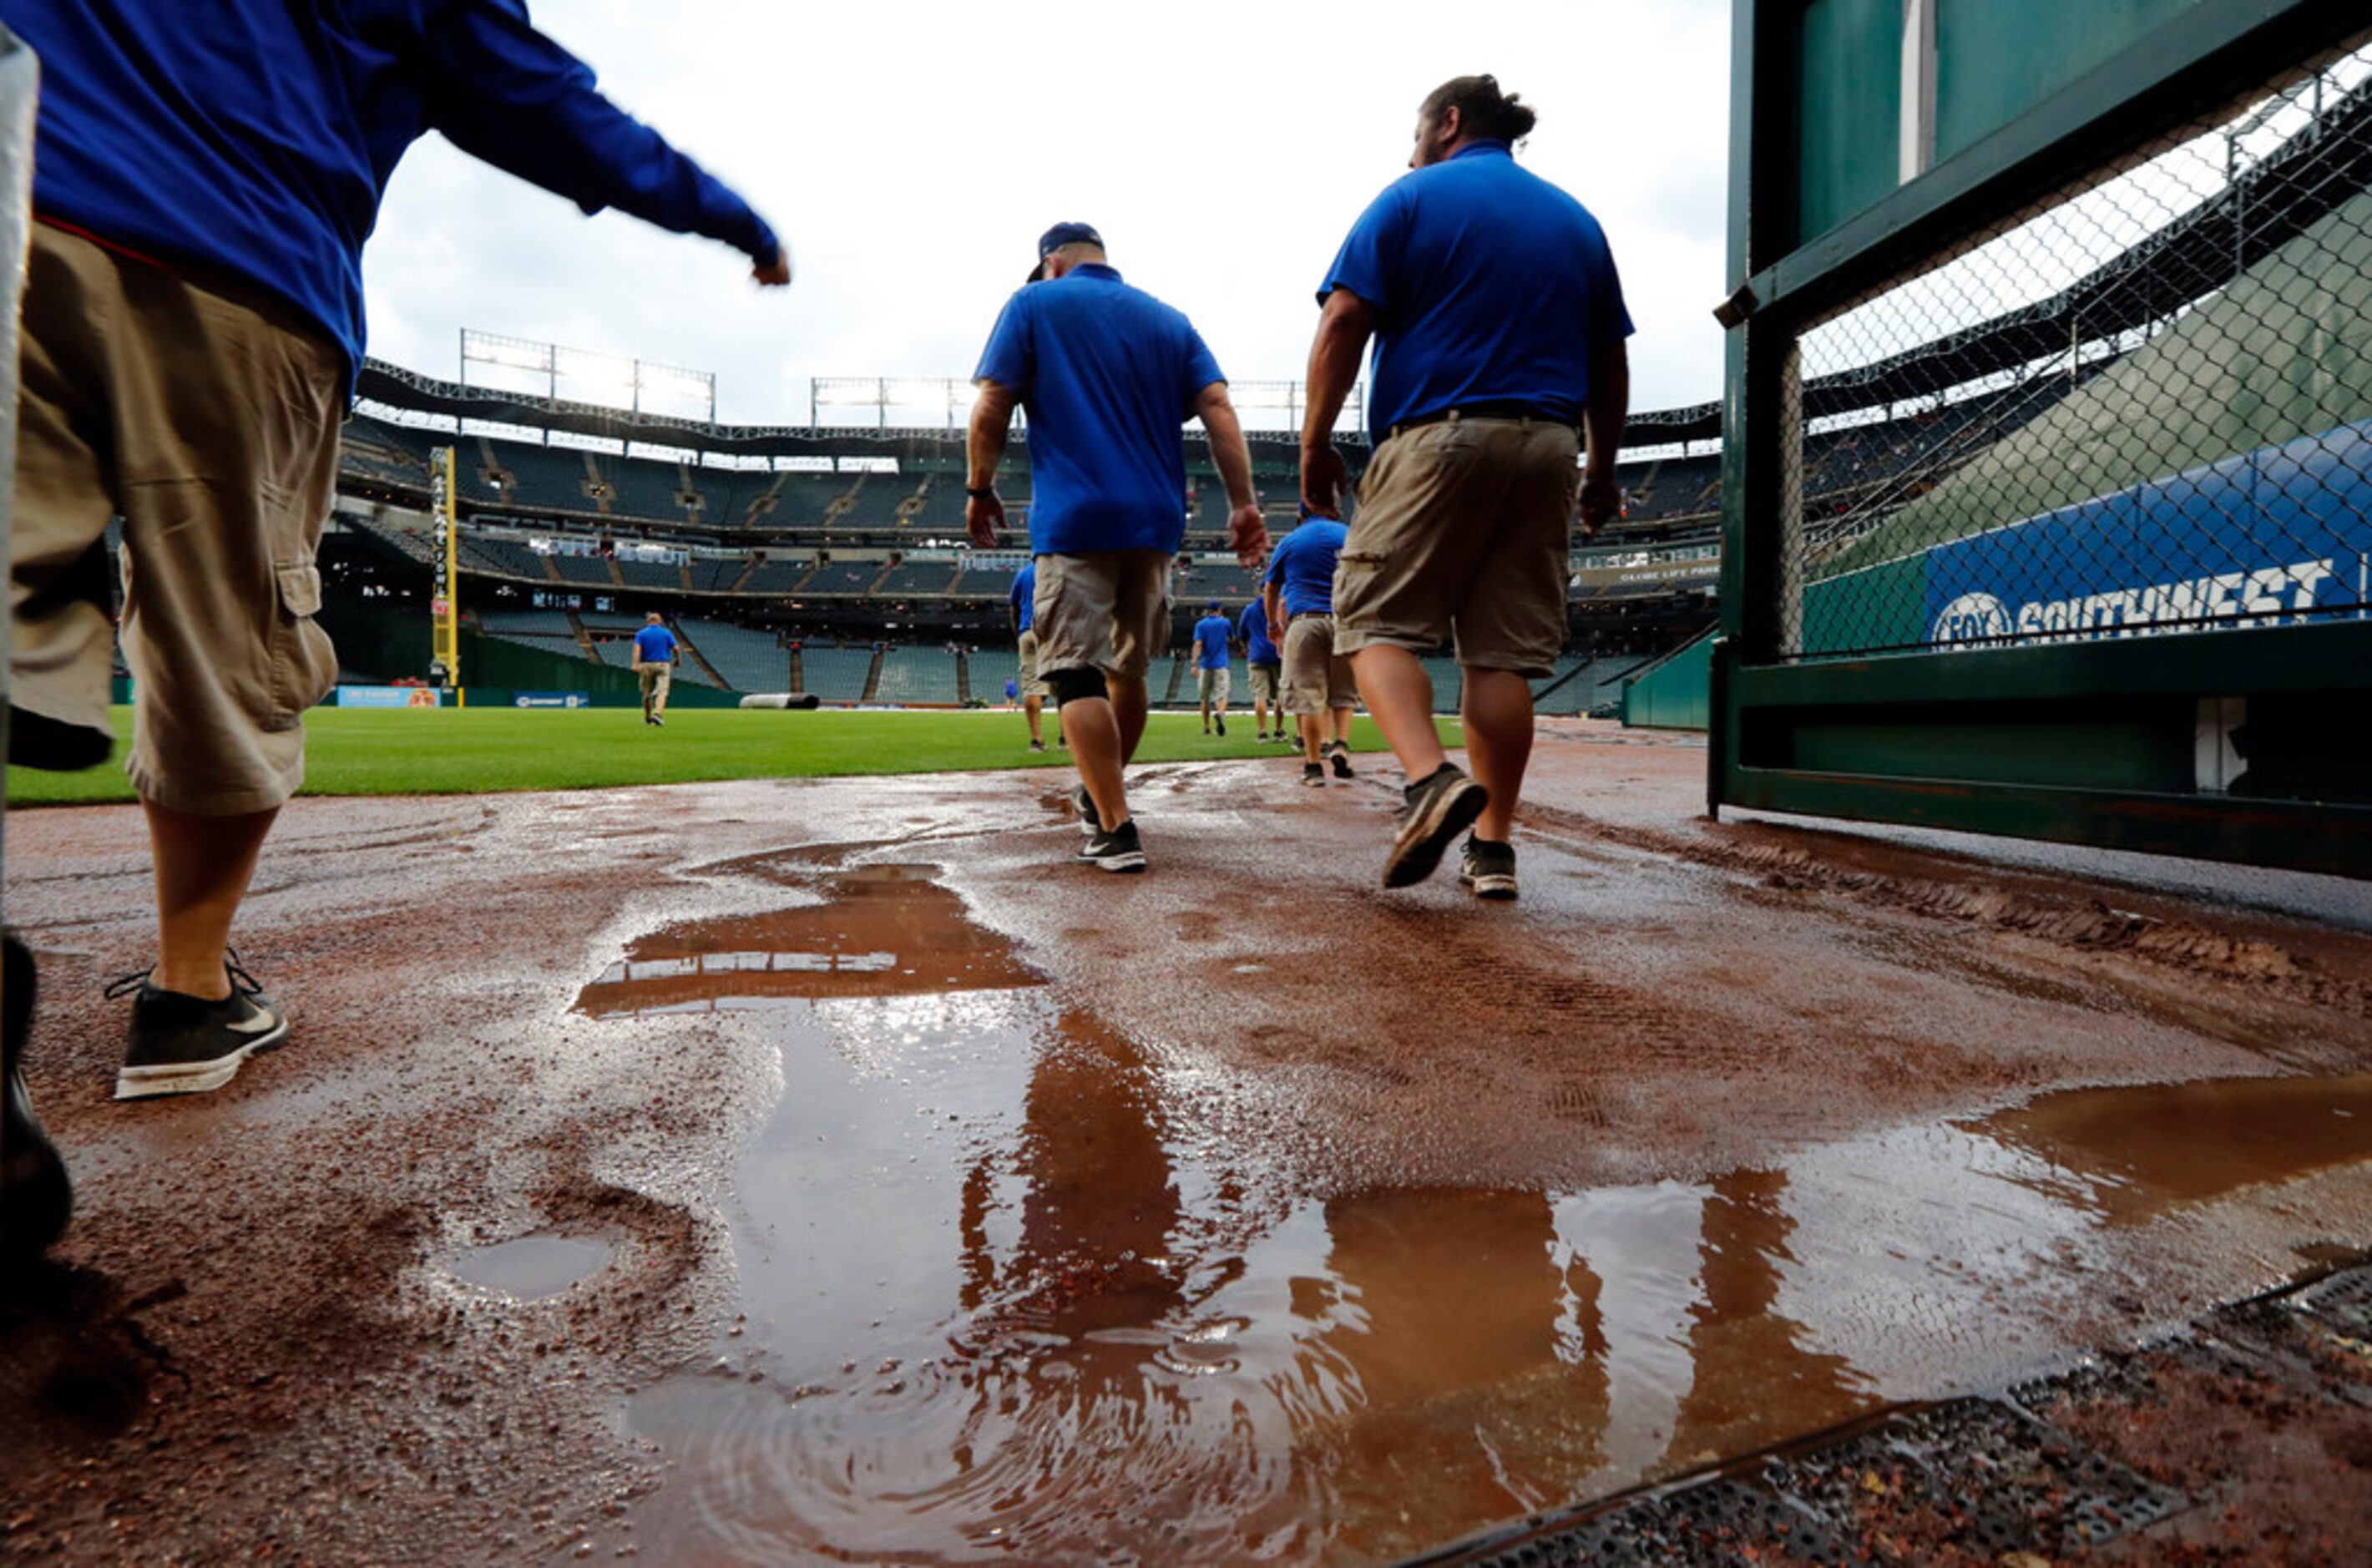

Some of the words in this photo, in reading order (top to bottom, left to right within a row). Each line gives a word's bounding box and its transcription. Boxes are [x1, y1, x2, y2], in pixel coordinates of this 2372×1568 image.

[1620, 572, 1659, 582] GLOBE
[1662, 569, 1687, 579] LIFE
[1690, 564, 1722, 576] PARK
[1949, 609, 1994, 647] FOX
[2015, 559, 2334, 647] SOUTHWEST
